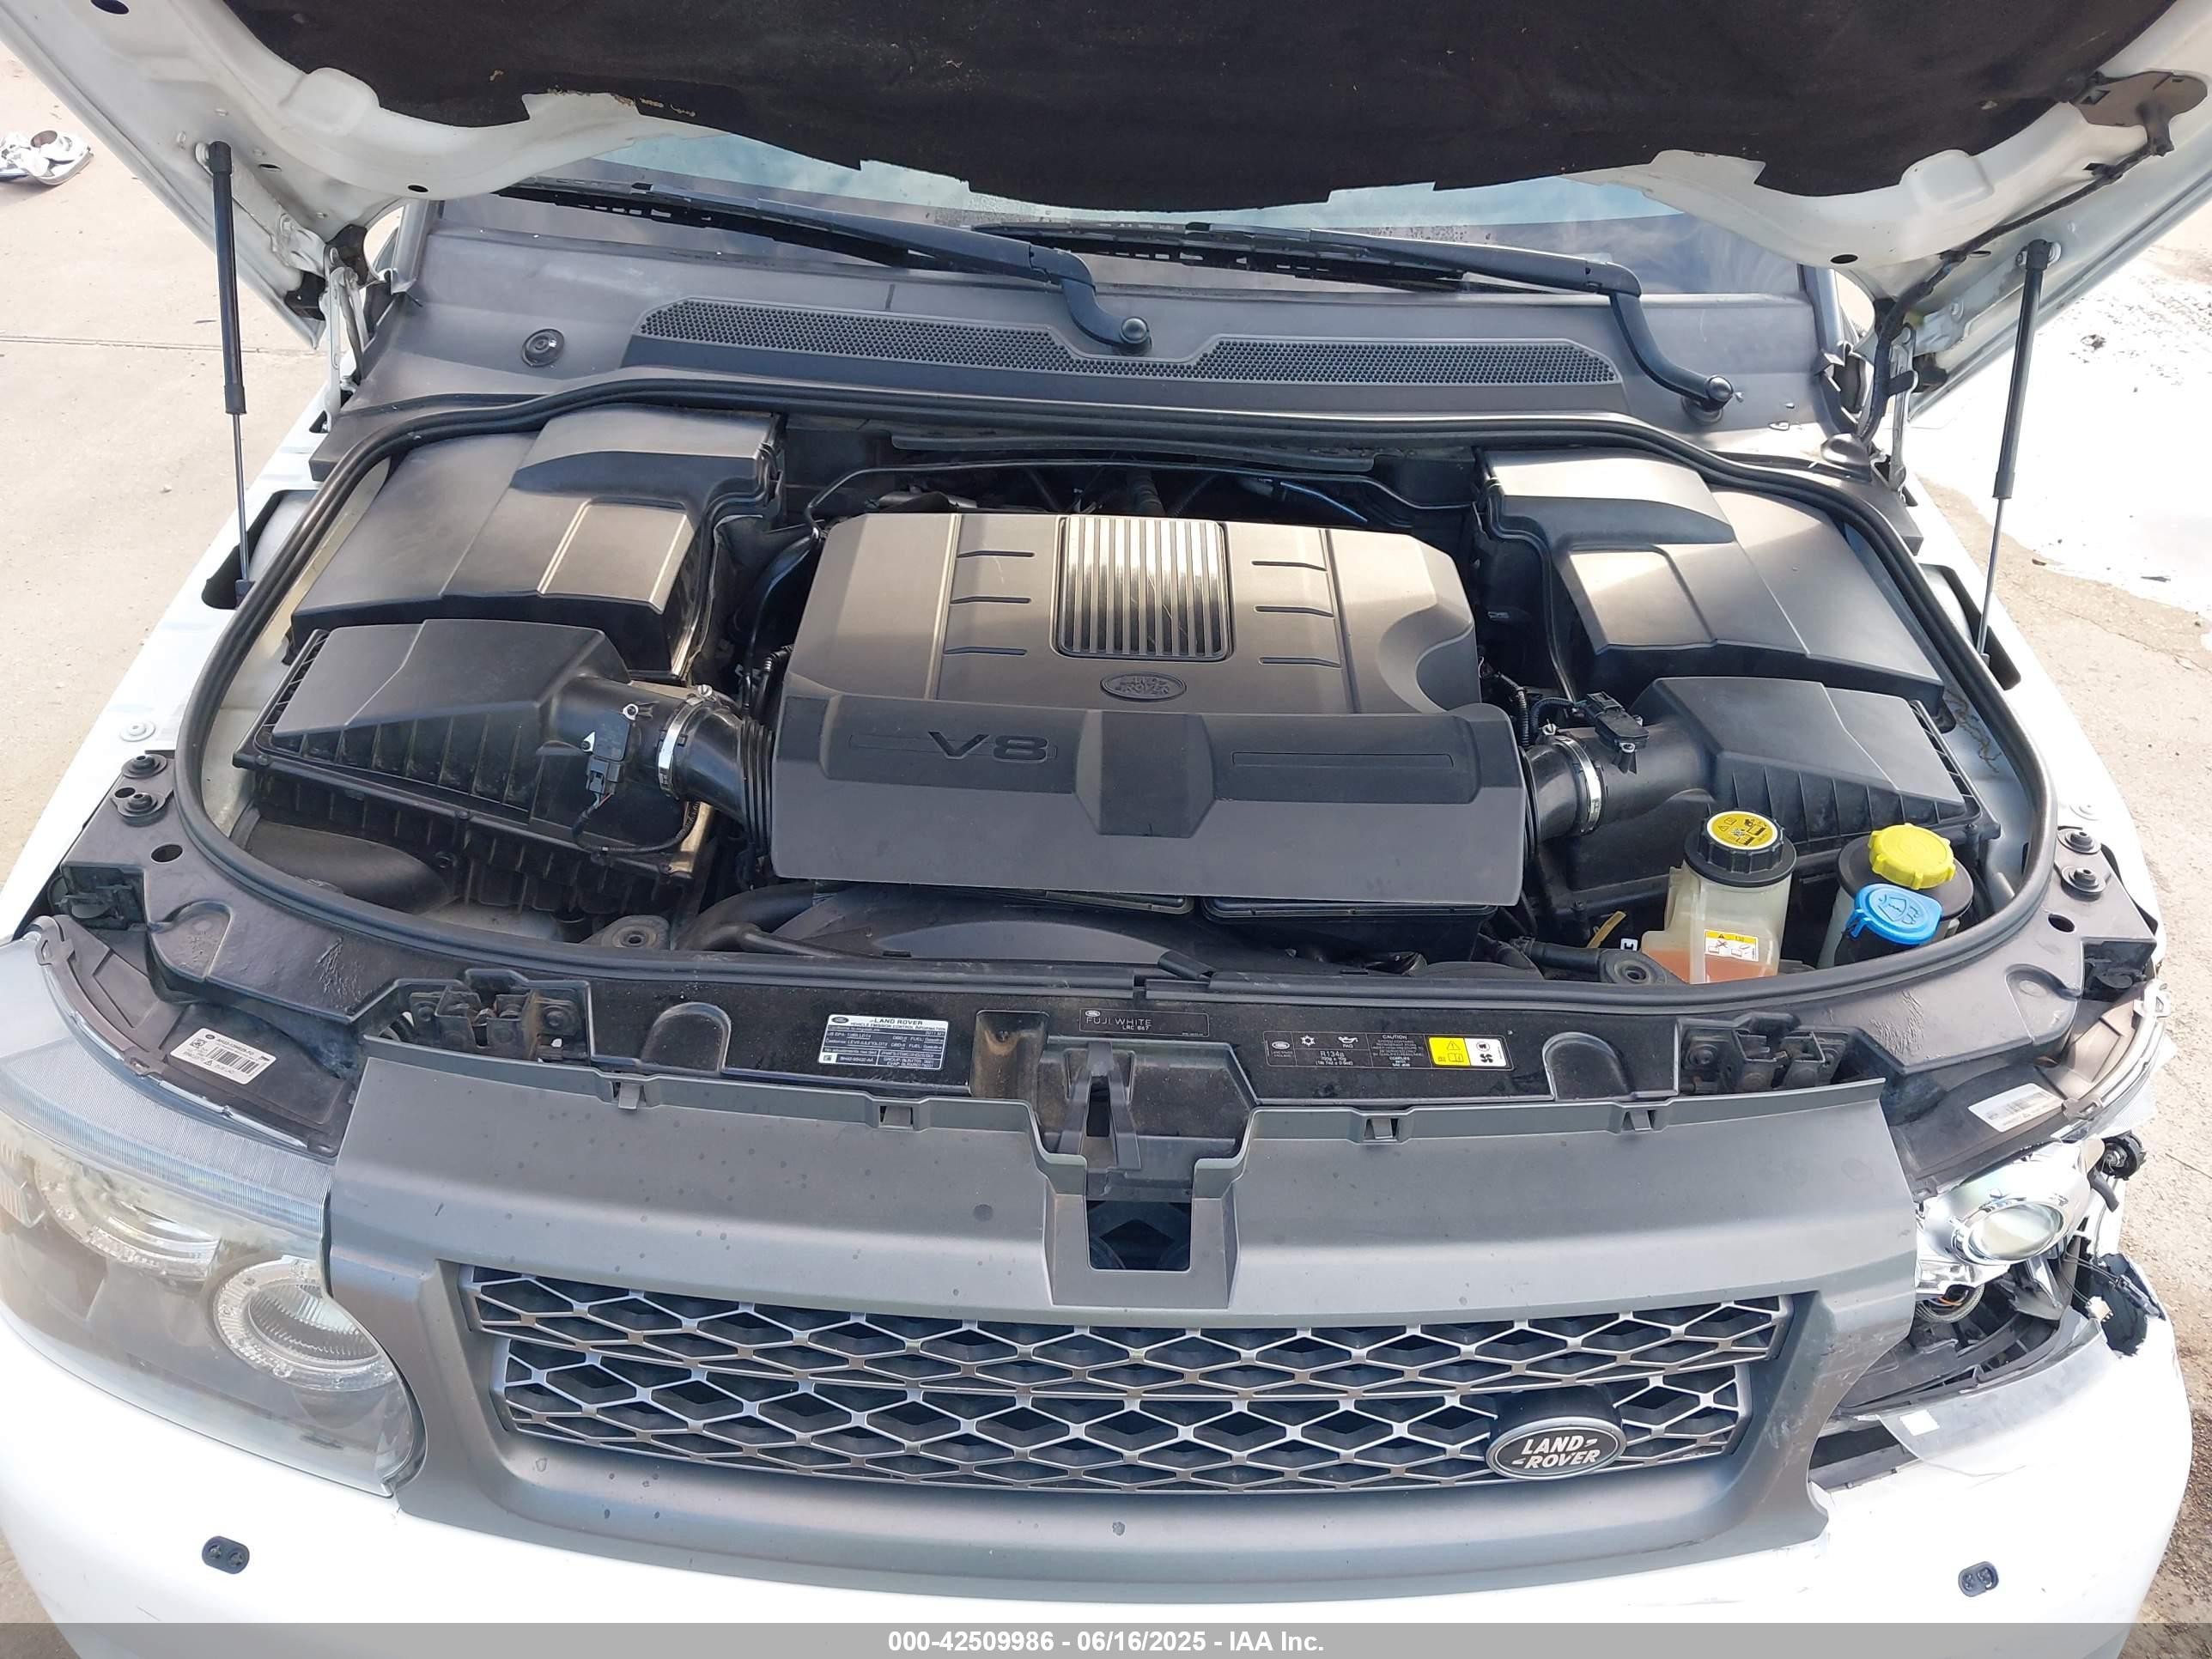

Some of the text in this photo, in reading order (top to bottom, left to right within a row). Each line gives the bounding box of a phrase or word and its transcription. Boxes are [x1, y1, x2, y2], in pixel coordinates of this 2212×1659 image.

[928, 731, 1048, 763] V8
[1115, 1018, 1152, 1026] WHITE
[1521, 1436, 1584, 1455] LAND
[1524, 1449, 1601, 1469] ROVER
